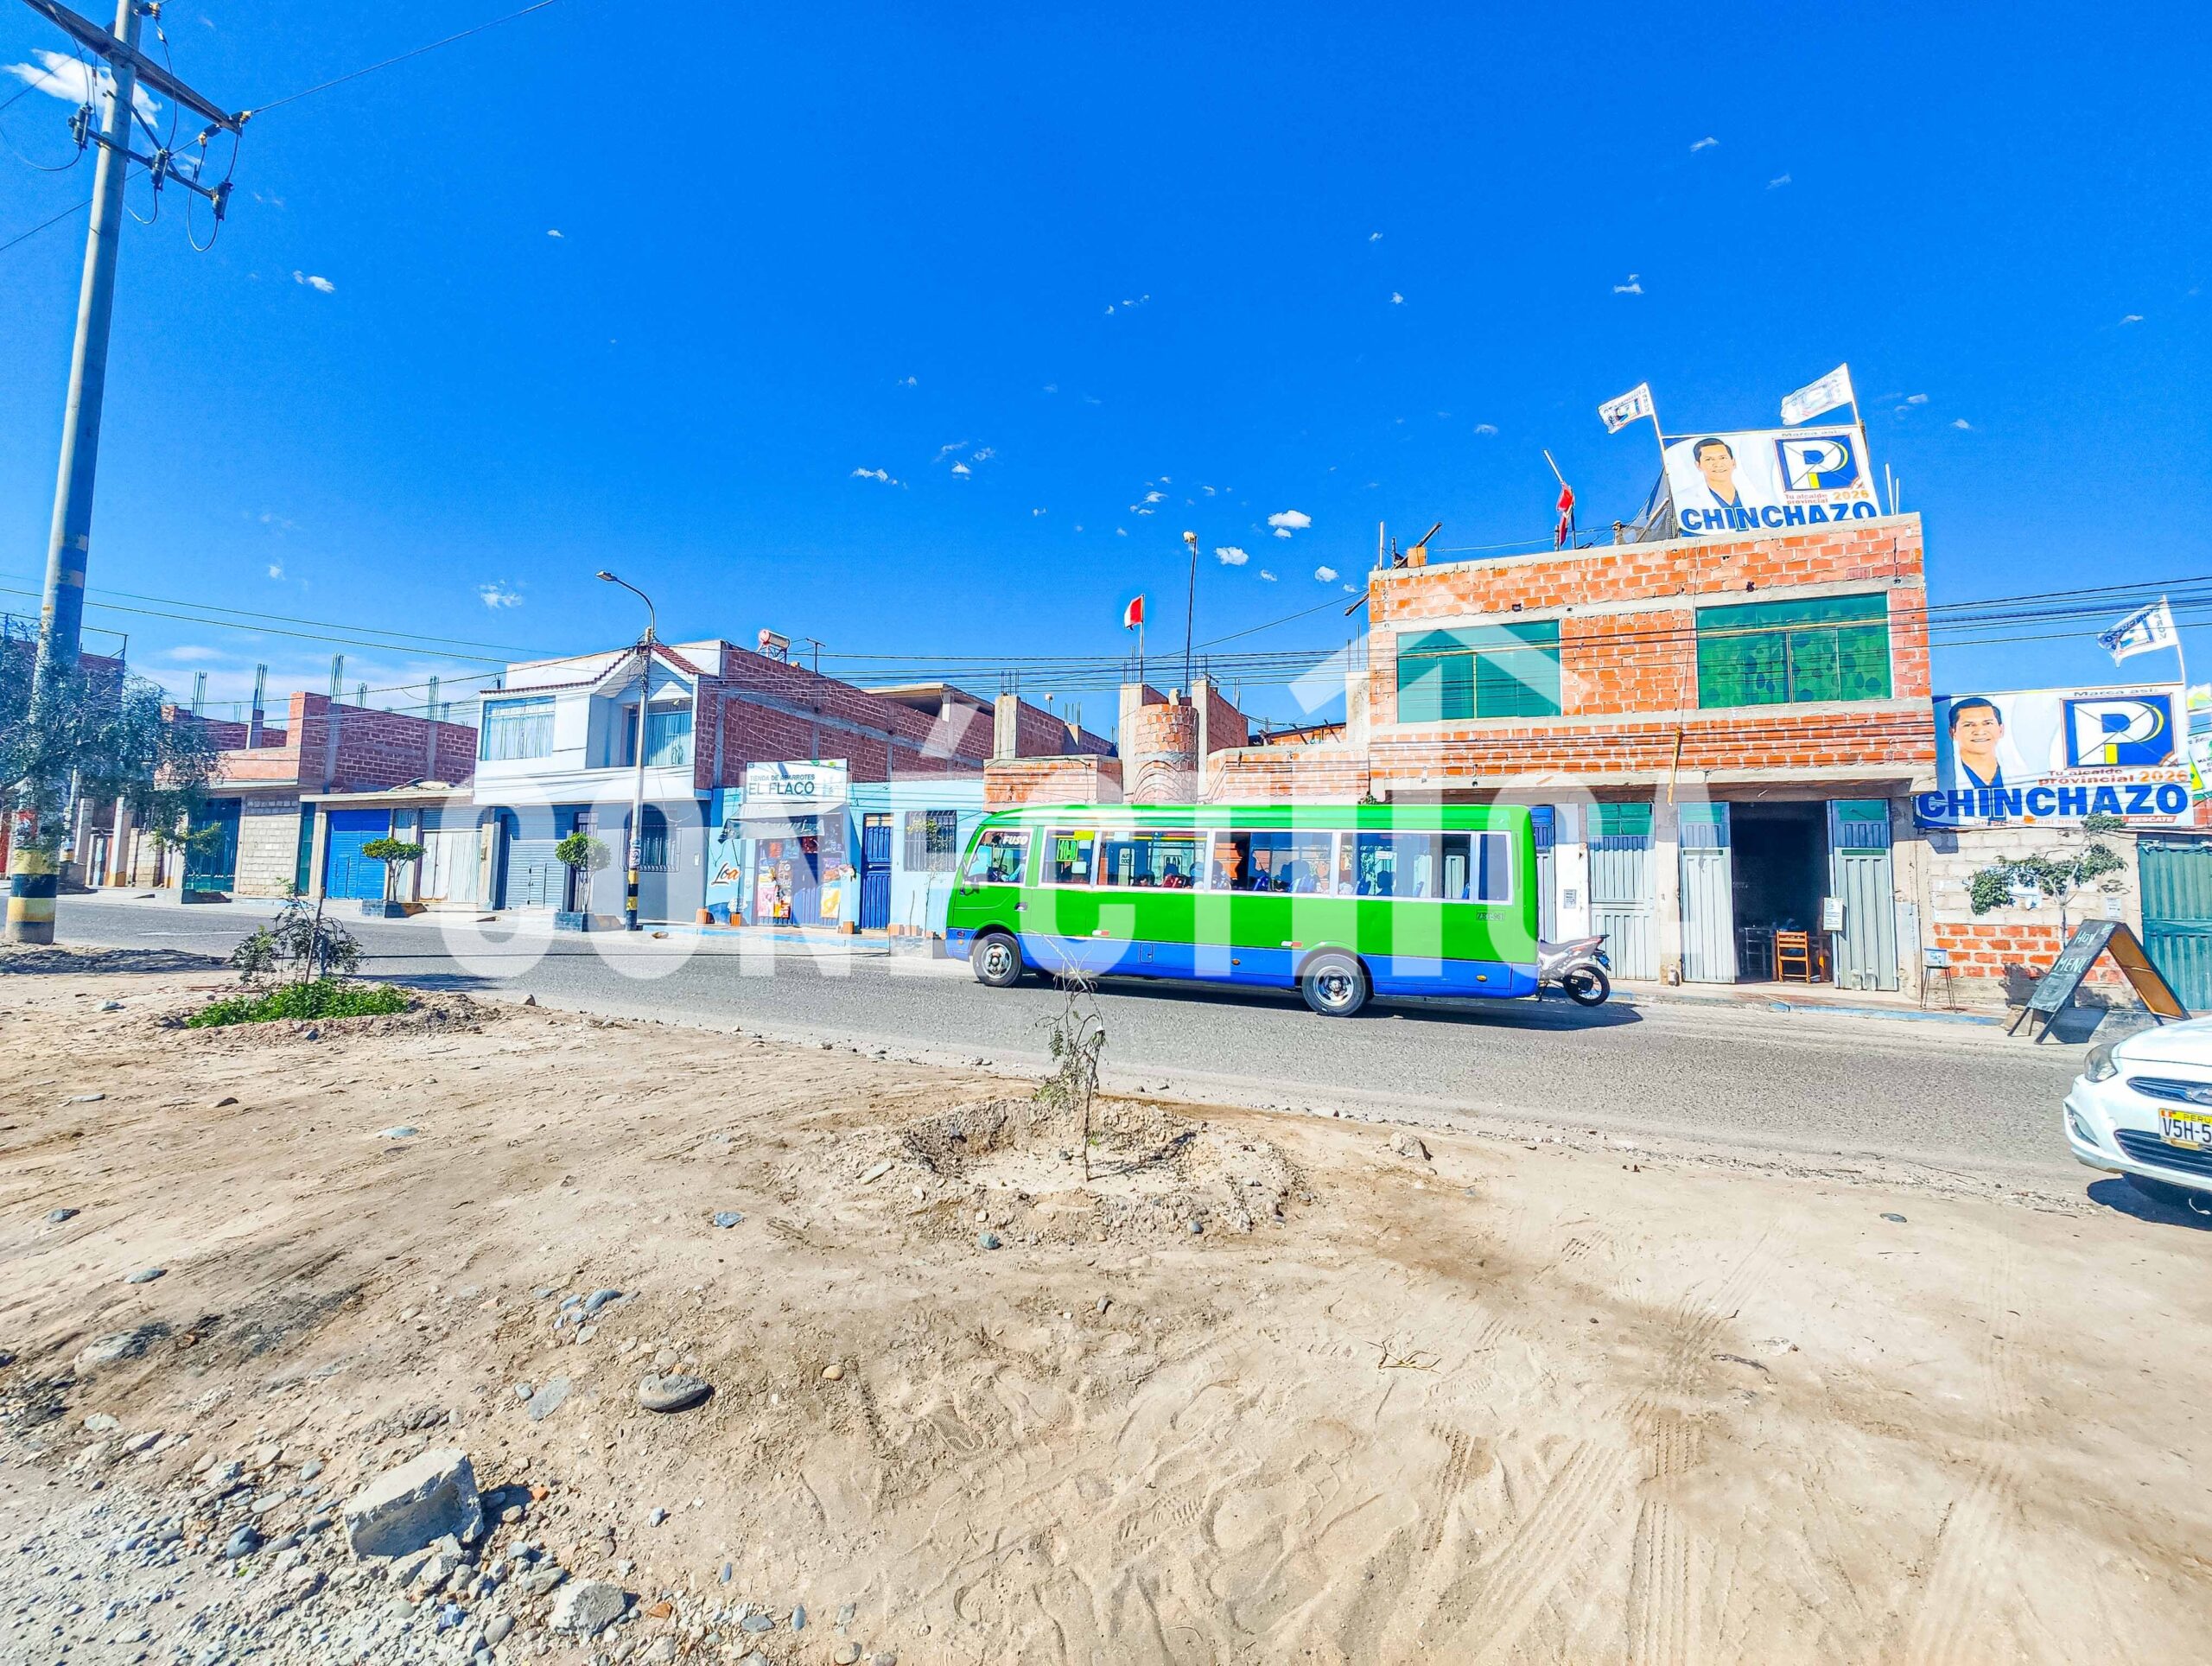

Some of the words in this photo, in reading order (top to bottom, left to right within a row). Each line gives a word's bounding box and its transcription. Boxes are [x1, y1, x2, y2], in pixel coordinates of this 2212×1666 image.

[1834, 490, 1870, 500] 2026
[1681, 501, 1878, 531] CHINCHAZO
[2038, 774, 2134, 785] provincial
[2139, 770, 2188, 782] 2026
[749, 782, 764, 795] EL
[769, 781, 815, 795] FLACO
[1918, 784, 2189, 817] CHINCHAZO
[1003, 835, 1028, 845] FUSO
[711, 862, 739, 886] Loa
